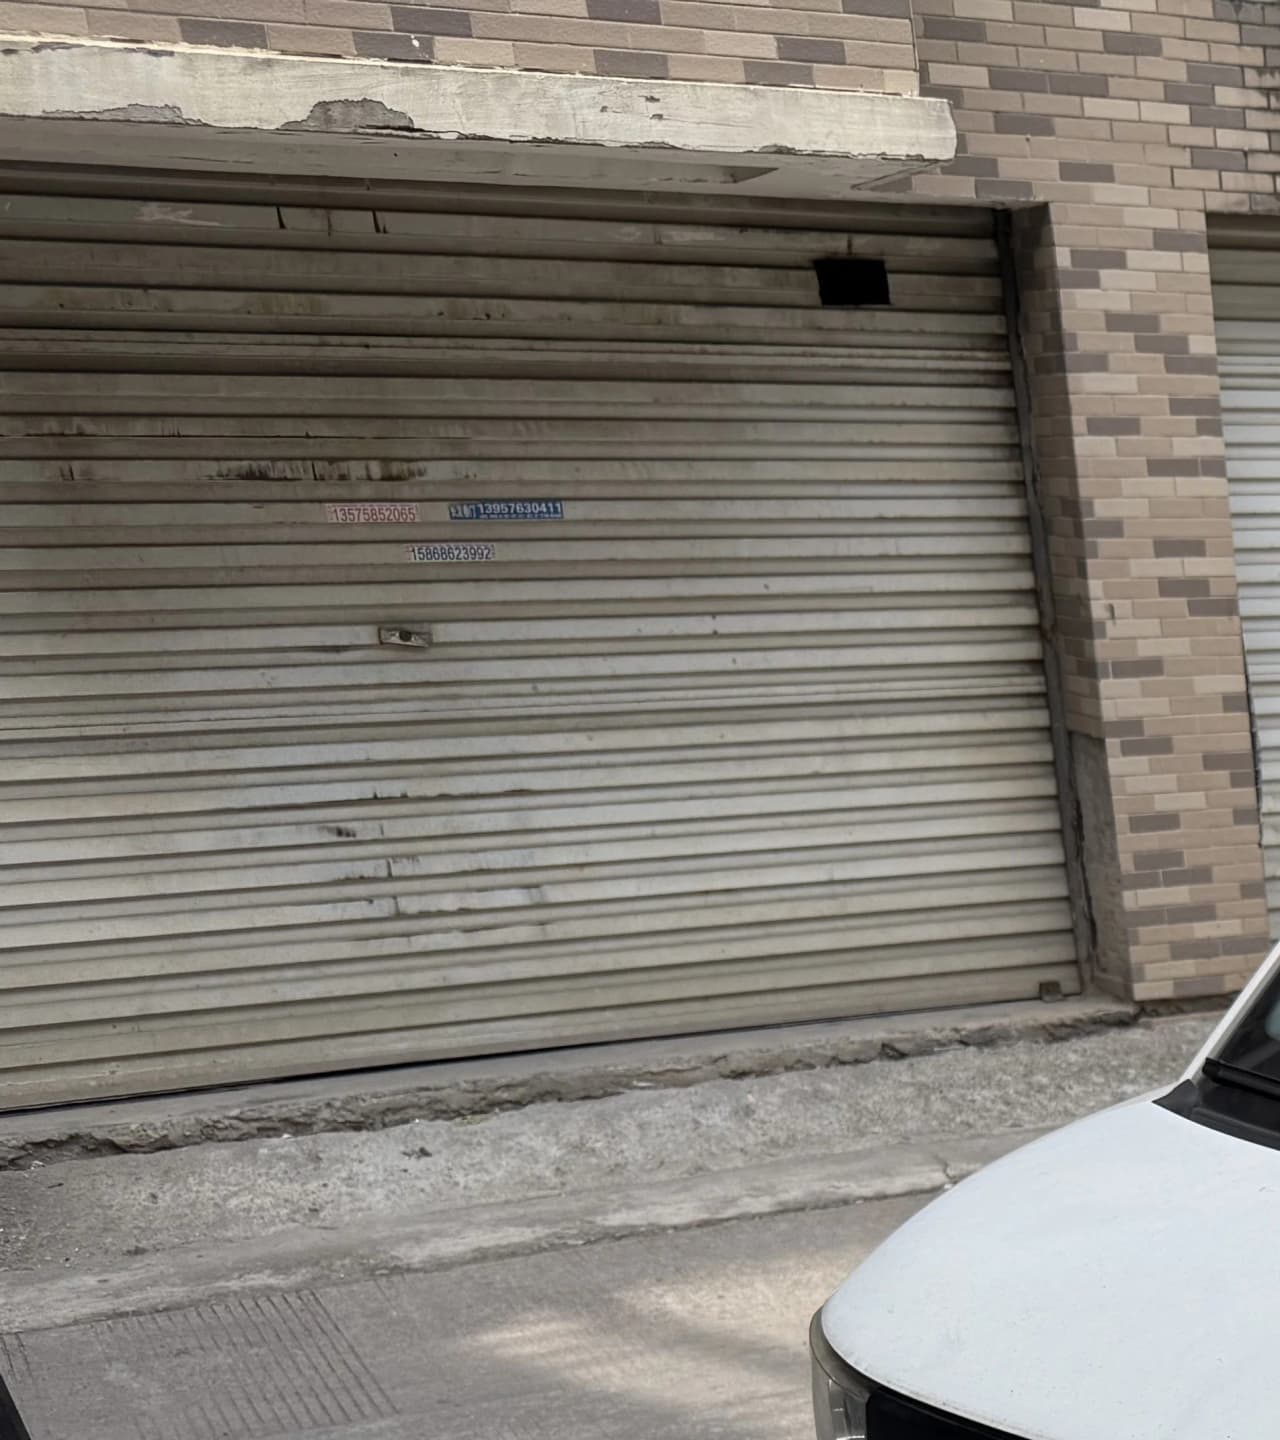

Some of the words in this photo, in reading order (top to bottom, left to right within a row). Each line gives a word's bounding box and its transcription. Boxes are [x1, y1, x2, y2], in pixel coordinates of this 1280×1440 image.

[333, 507, 416, 522] 13575852065
[477, 502, 561, 514] 13957630411
[411, 546, 491, 561] 15868623992
